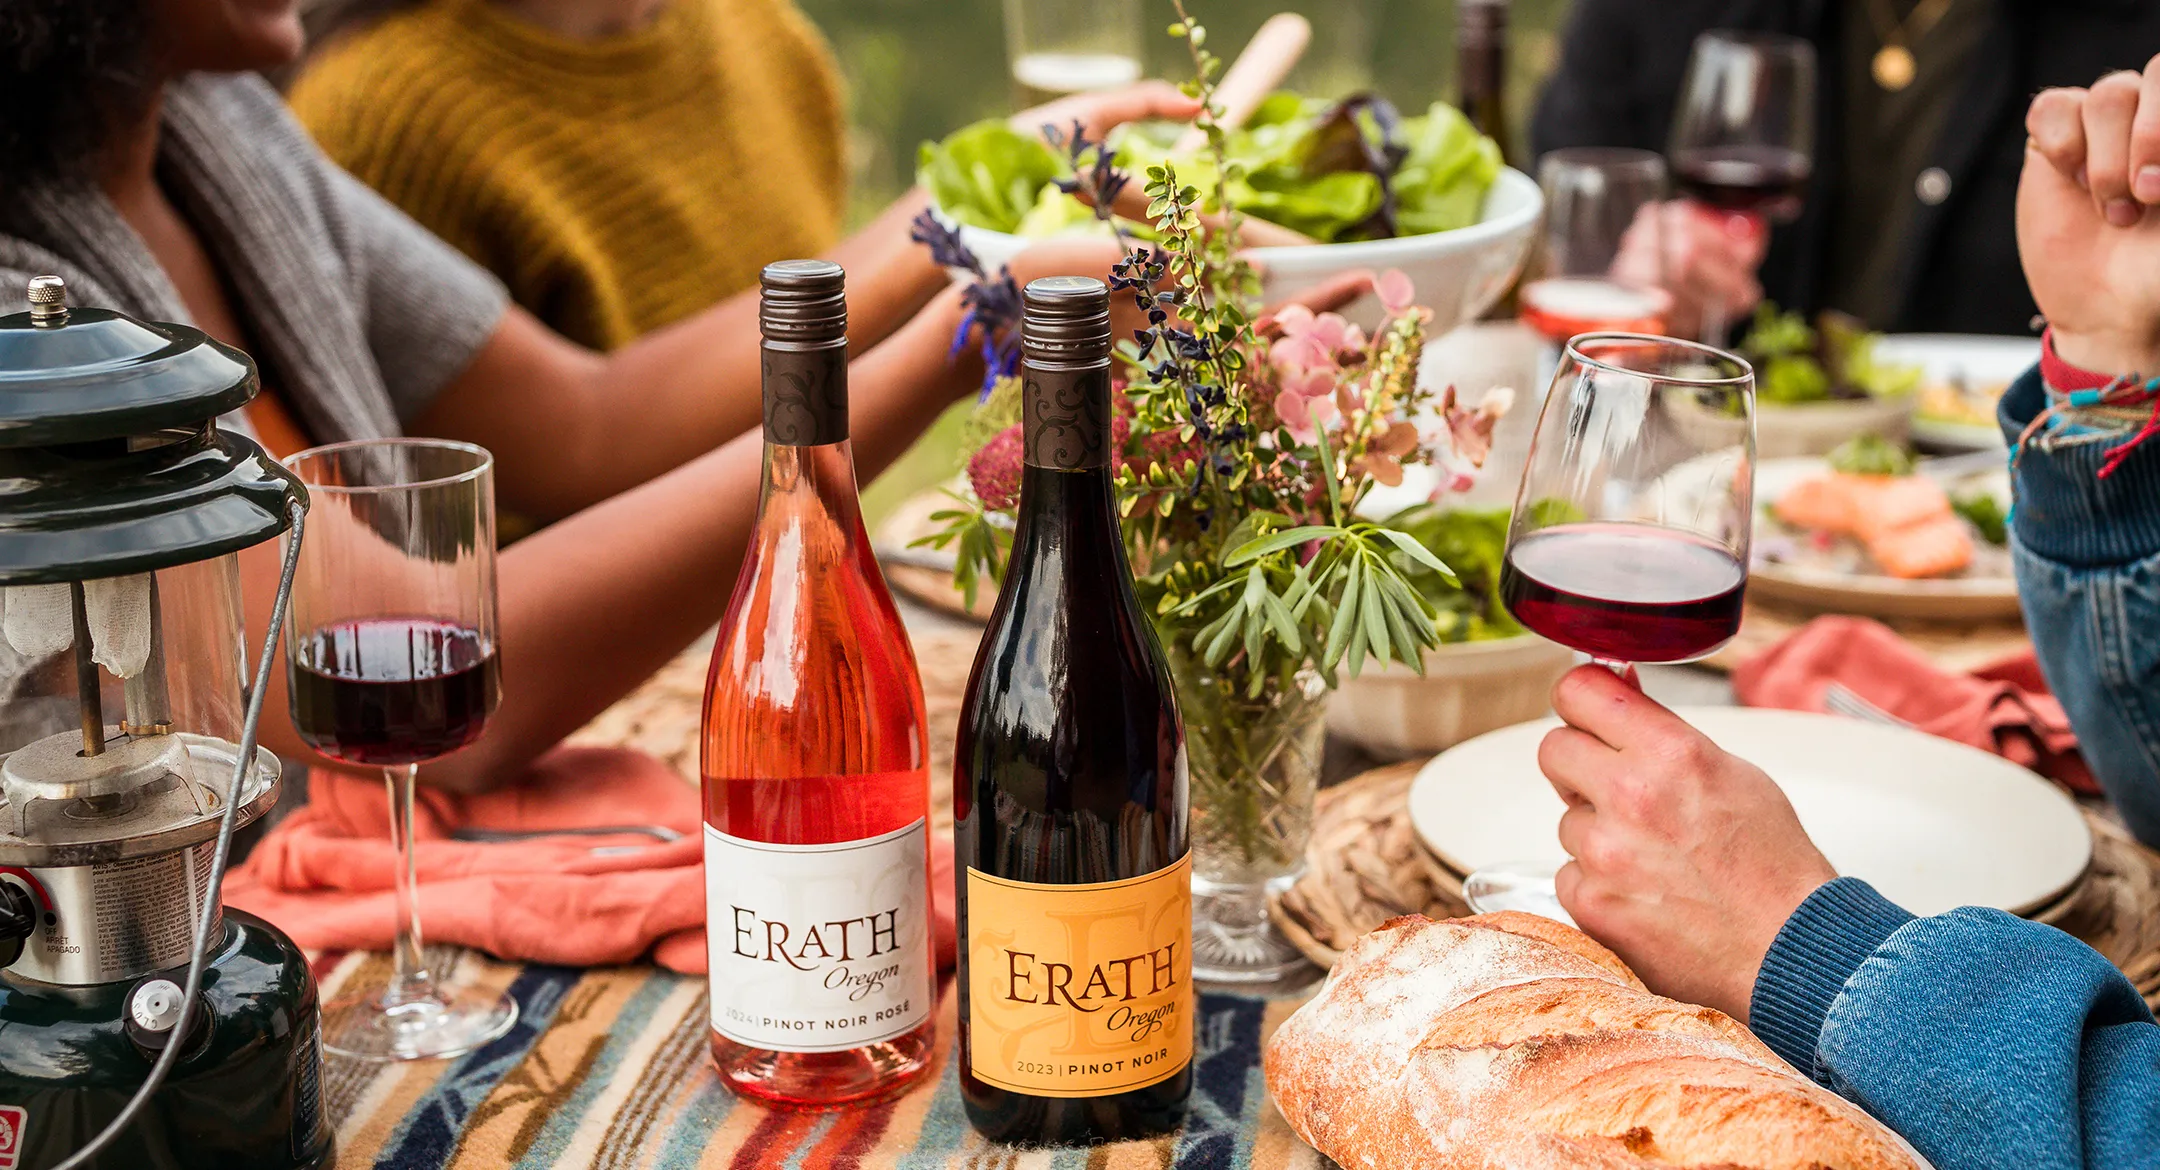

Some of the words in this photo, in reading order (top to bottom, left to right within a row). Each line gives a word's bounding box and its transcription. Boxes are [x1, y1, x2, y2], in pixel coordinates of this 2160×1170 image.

[47, 945, 80, 954] APAGADO
[730, 904, 901, 971] ERATH
[824, 964, 899, 1001] Oregon
[1004, 942, 1177, 1012] ERATH
[725, 1007, 754, 1025] 2024
[763, 1018, 815, 1031] PINOT
[825, 1015, 867, 1030] NOIR
[876, 999, 910, 1021] ROSÉ
[1107, 1000, 1175, 1042] Oregon
[1017, 1061, 1054, 1075] 2023
[1069, 1060, 1124, 1075] PINOT
[1132, 1048, 1168, 1068] NOIR
